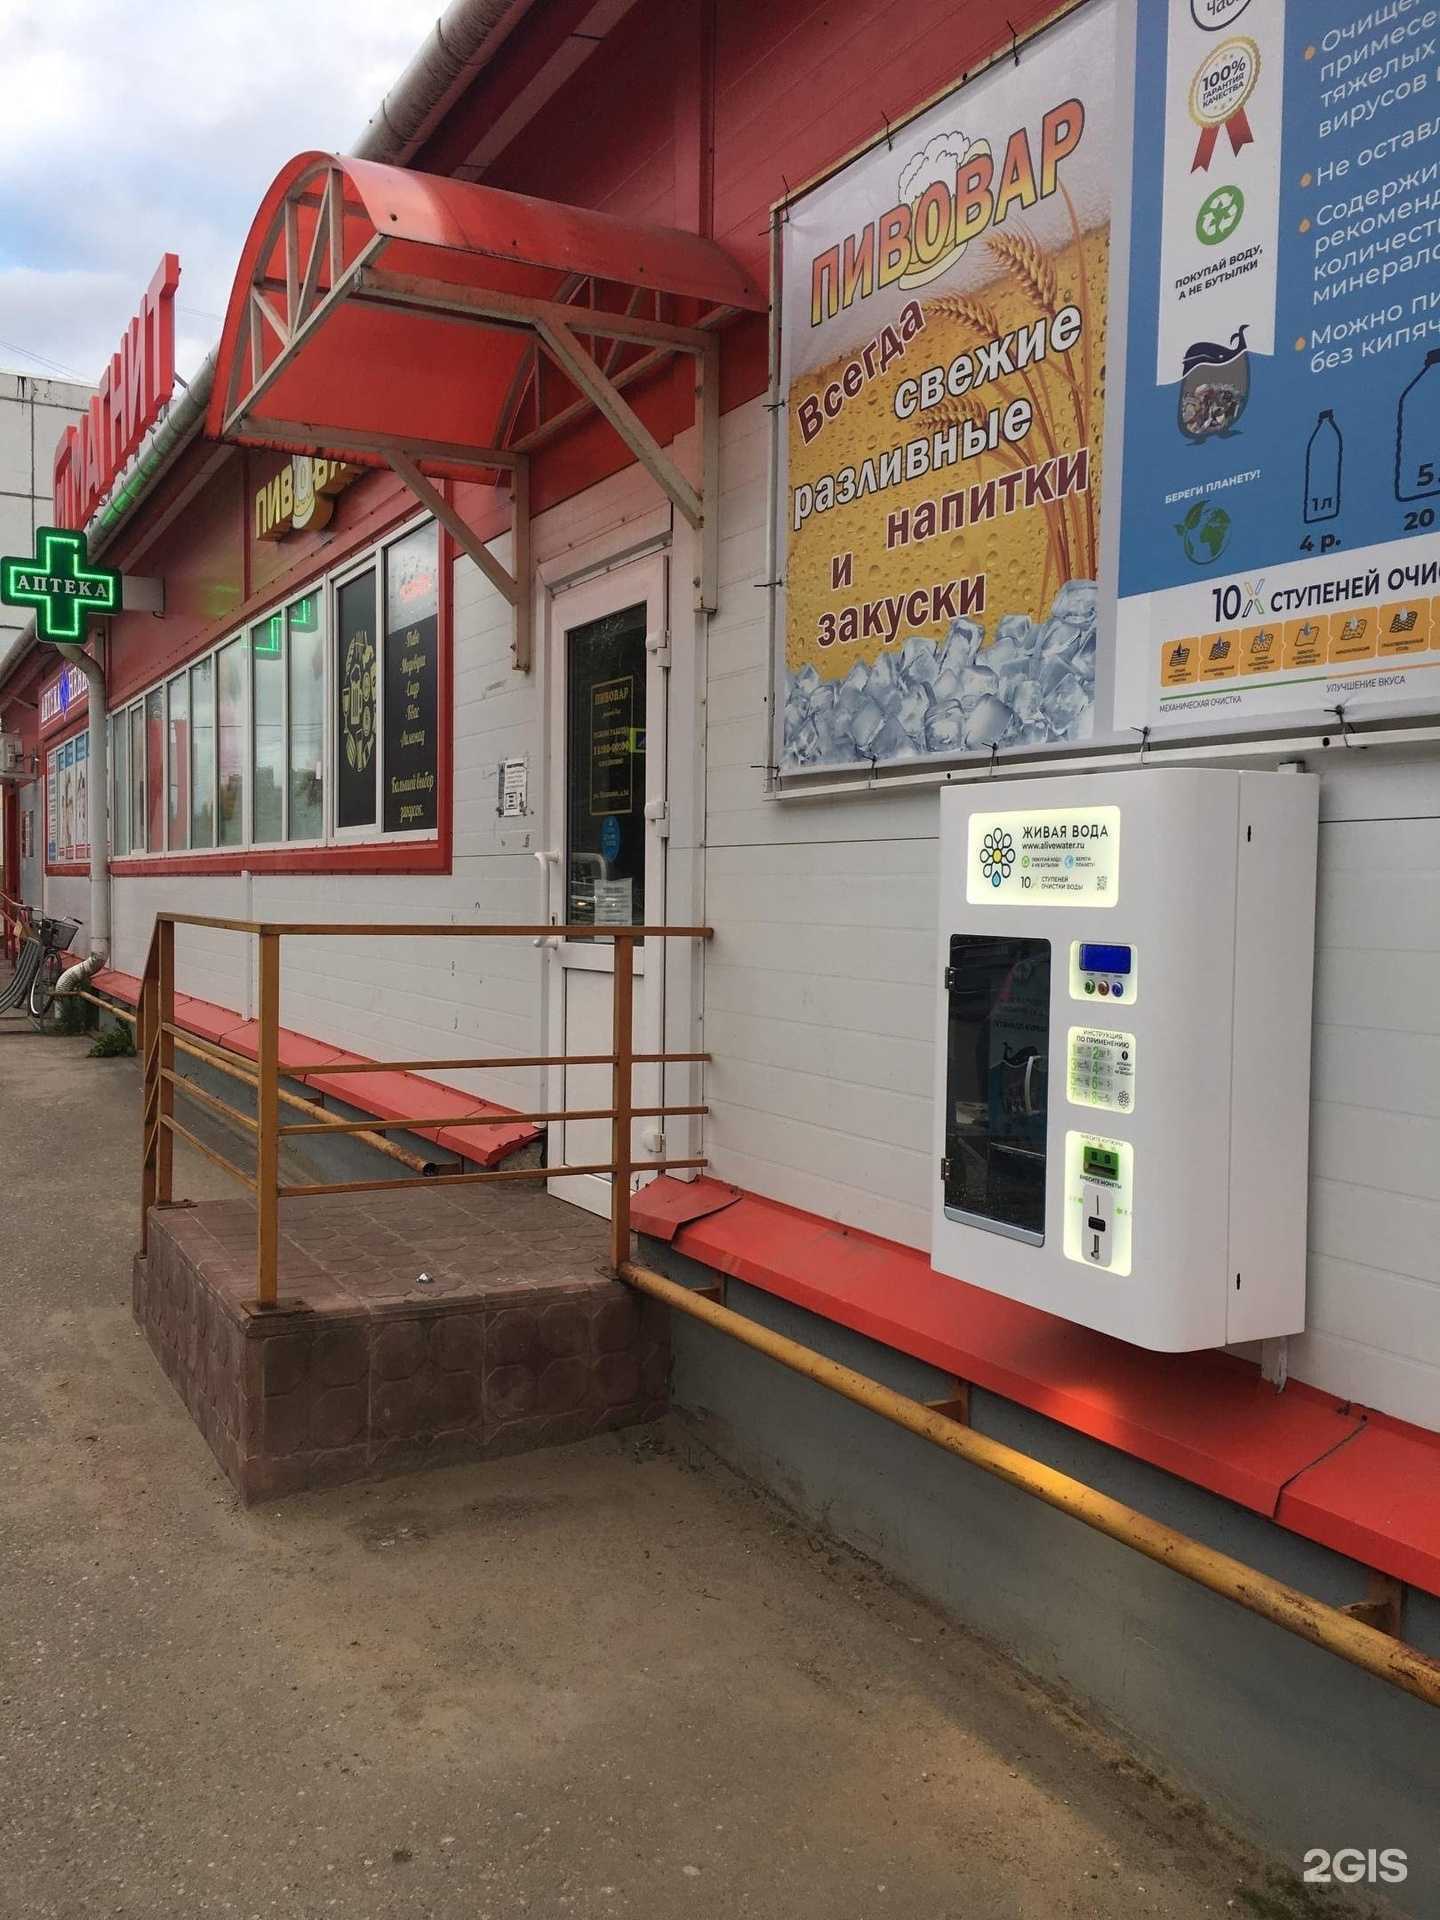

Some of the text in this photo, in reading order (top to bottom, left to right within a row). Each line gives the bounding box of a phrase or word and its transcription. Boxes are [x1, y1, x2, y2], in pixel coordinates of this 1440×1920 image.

[1322, 0, 1420, 51] Очище
[1202, 56, 1246, 92] 100%
[1203, 72, 1244, 100] ГАРАНТИЯ
[1321, 39, 1437, 108] тяжелых
[1203, 81, 1244, 108] КАЧЕСТВА
[1320, 74, 1427, 138] вирусов
[1317, 160, 1350, 186] Не
[811, 98, 1085, 328] ПИВОВАР
[1175, 244, 1263, 288] ПОКУПАЙ ВОДУ,
[1314, 218, 1440, 281] количест
[1178, 259, 1258, 300] А НЕ БУТЫЛКИ
[1311, 304, 1402, 349] Можно
[798, 299, 926, 447] Всегда
[894, 305, 1082, 419] свежие
[1311, 347, 1353, 373] без
[793, 398, 1033, 531] разливные
[886, 447, 1090, 550] напитки
[1165, 469, 1261, 504] БЕРЕГИ ПЛАНЕТУ!
[1404, 508, 1435, 531] 20
[1300, 533, 1342, 553] 4 р.
[17, 575, 107, 598] АПТЕКА
[831, 552, 853, 590] и
[1271, 568, 1380, 612] СТУПЕНЕЙ
[1387, 561, 1440, 590] ОЧИ
[817, 574, 986, 647] закуски
[1160, 695, 1242, 713] МЕХАНИЧЕСКАЯ ОЧИСТКА
[1326, 676, 1406, 693] УЛУЧШЕНИЕ ВКУСА
[1022, 824, 1109, 840] ЖИВАЯ ВОДА
[1086, 1036, 1130, 1049] ПРИМЕНЕНИЮ
